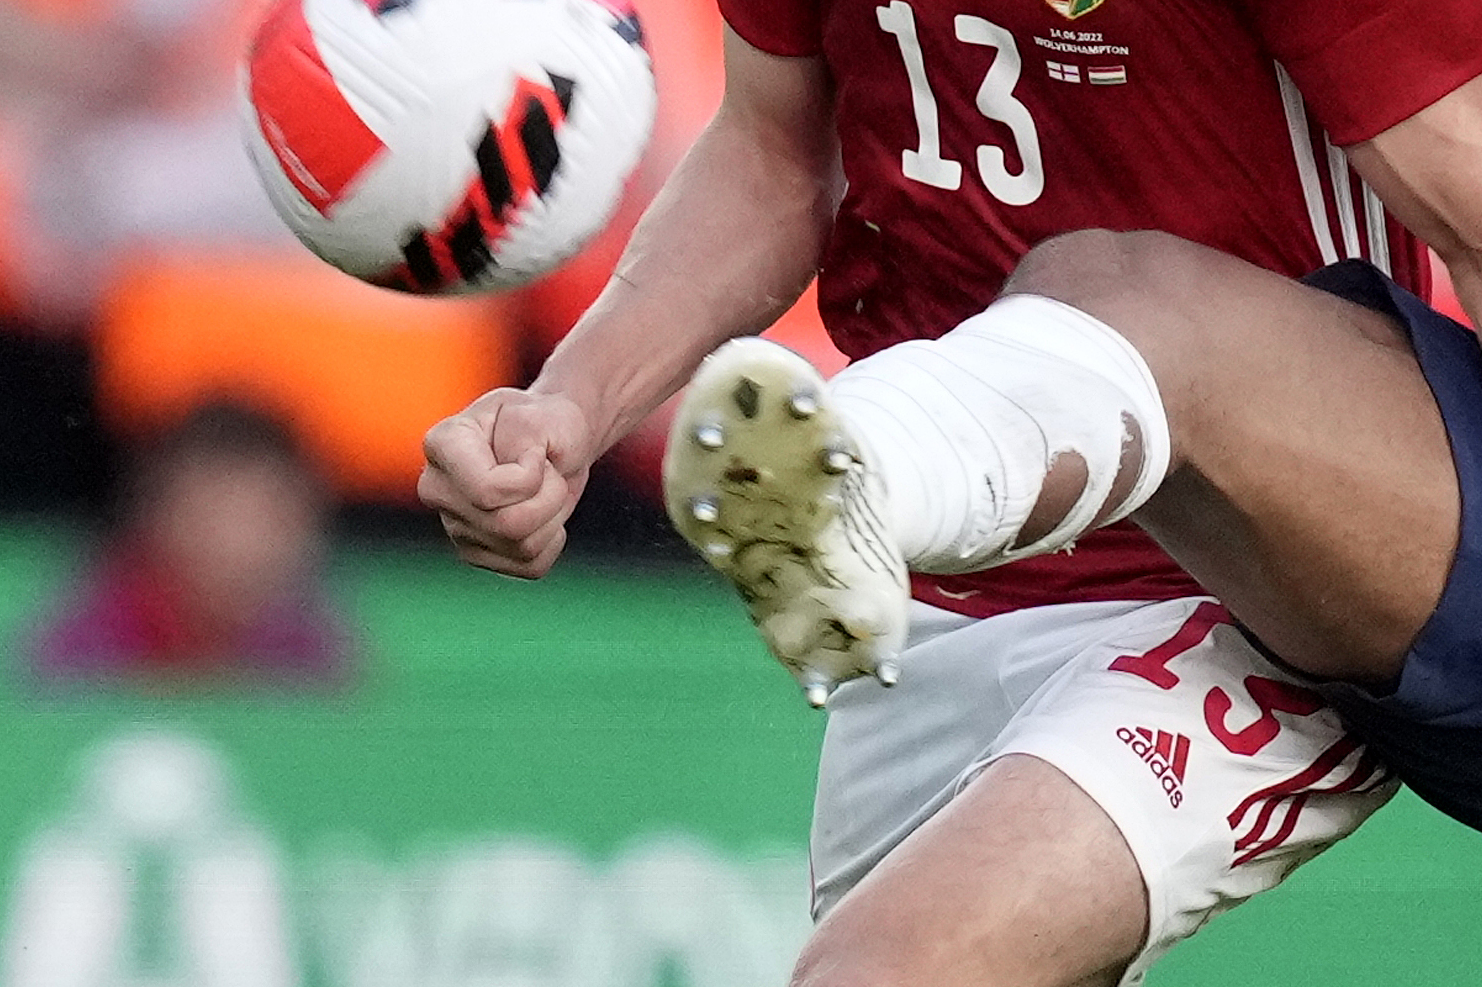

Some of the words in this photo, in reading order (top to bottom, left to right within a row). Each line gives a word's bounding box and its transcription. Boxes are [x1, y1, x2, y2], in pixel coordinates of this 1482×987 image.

[1033, 35, 1130, 56] WOLVERHAMPTON
[875, 0, 1045, 206] 13
[1116, 726, 1184, 809] adidas
